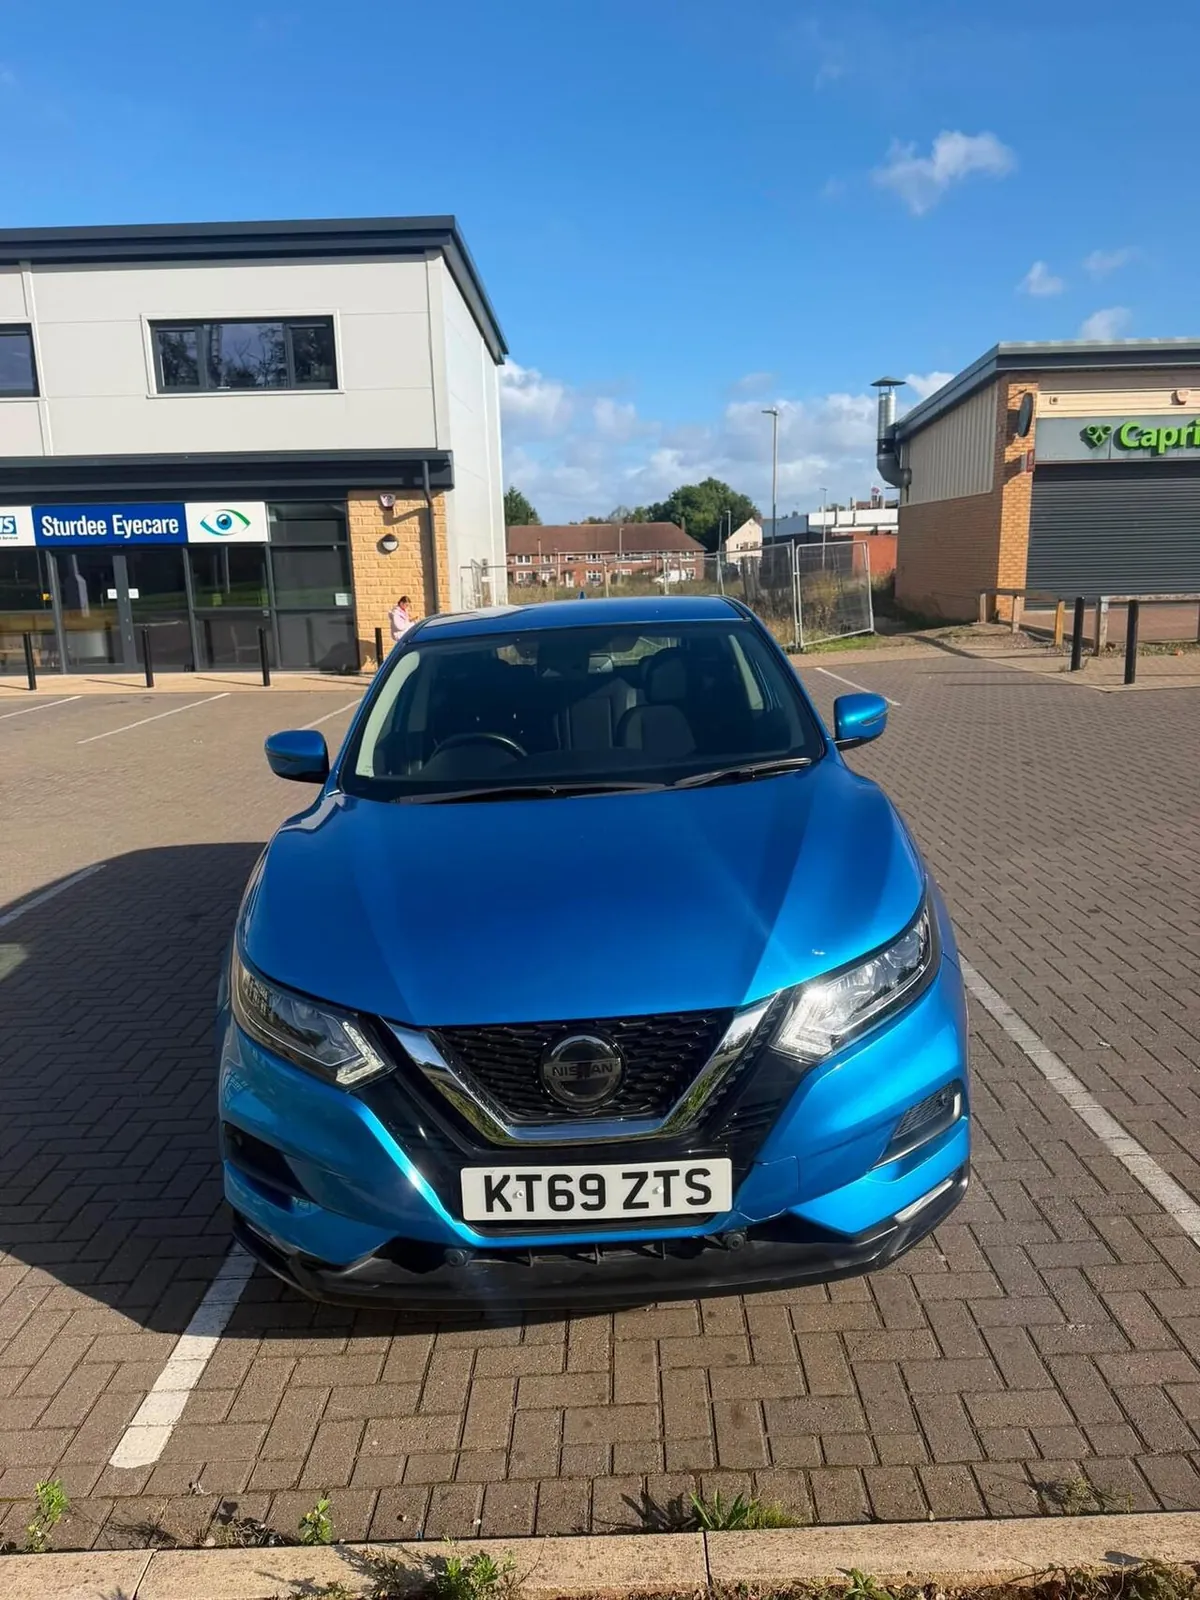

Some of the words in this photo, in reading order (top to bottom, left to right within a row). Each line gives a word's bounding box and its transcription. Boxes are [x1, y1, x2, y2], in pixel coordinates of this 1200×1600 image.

[41, 515, 107, 536] Sturdee
[112, 514, 179, 539] Eyecare
[552, 1063, 613, 1077] NISAN
[484, 1174, 606, 1212] KT69
[622, 1168, 712, 1210] ZTS
